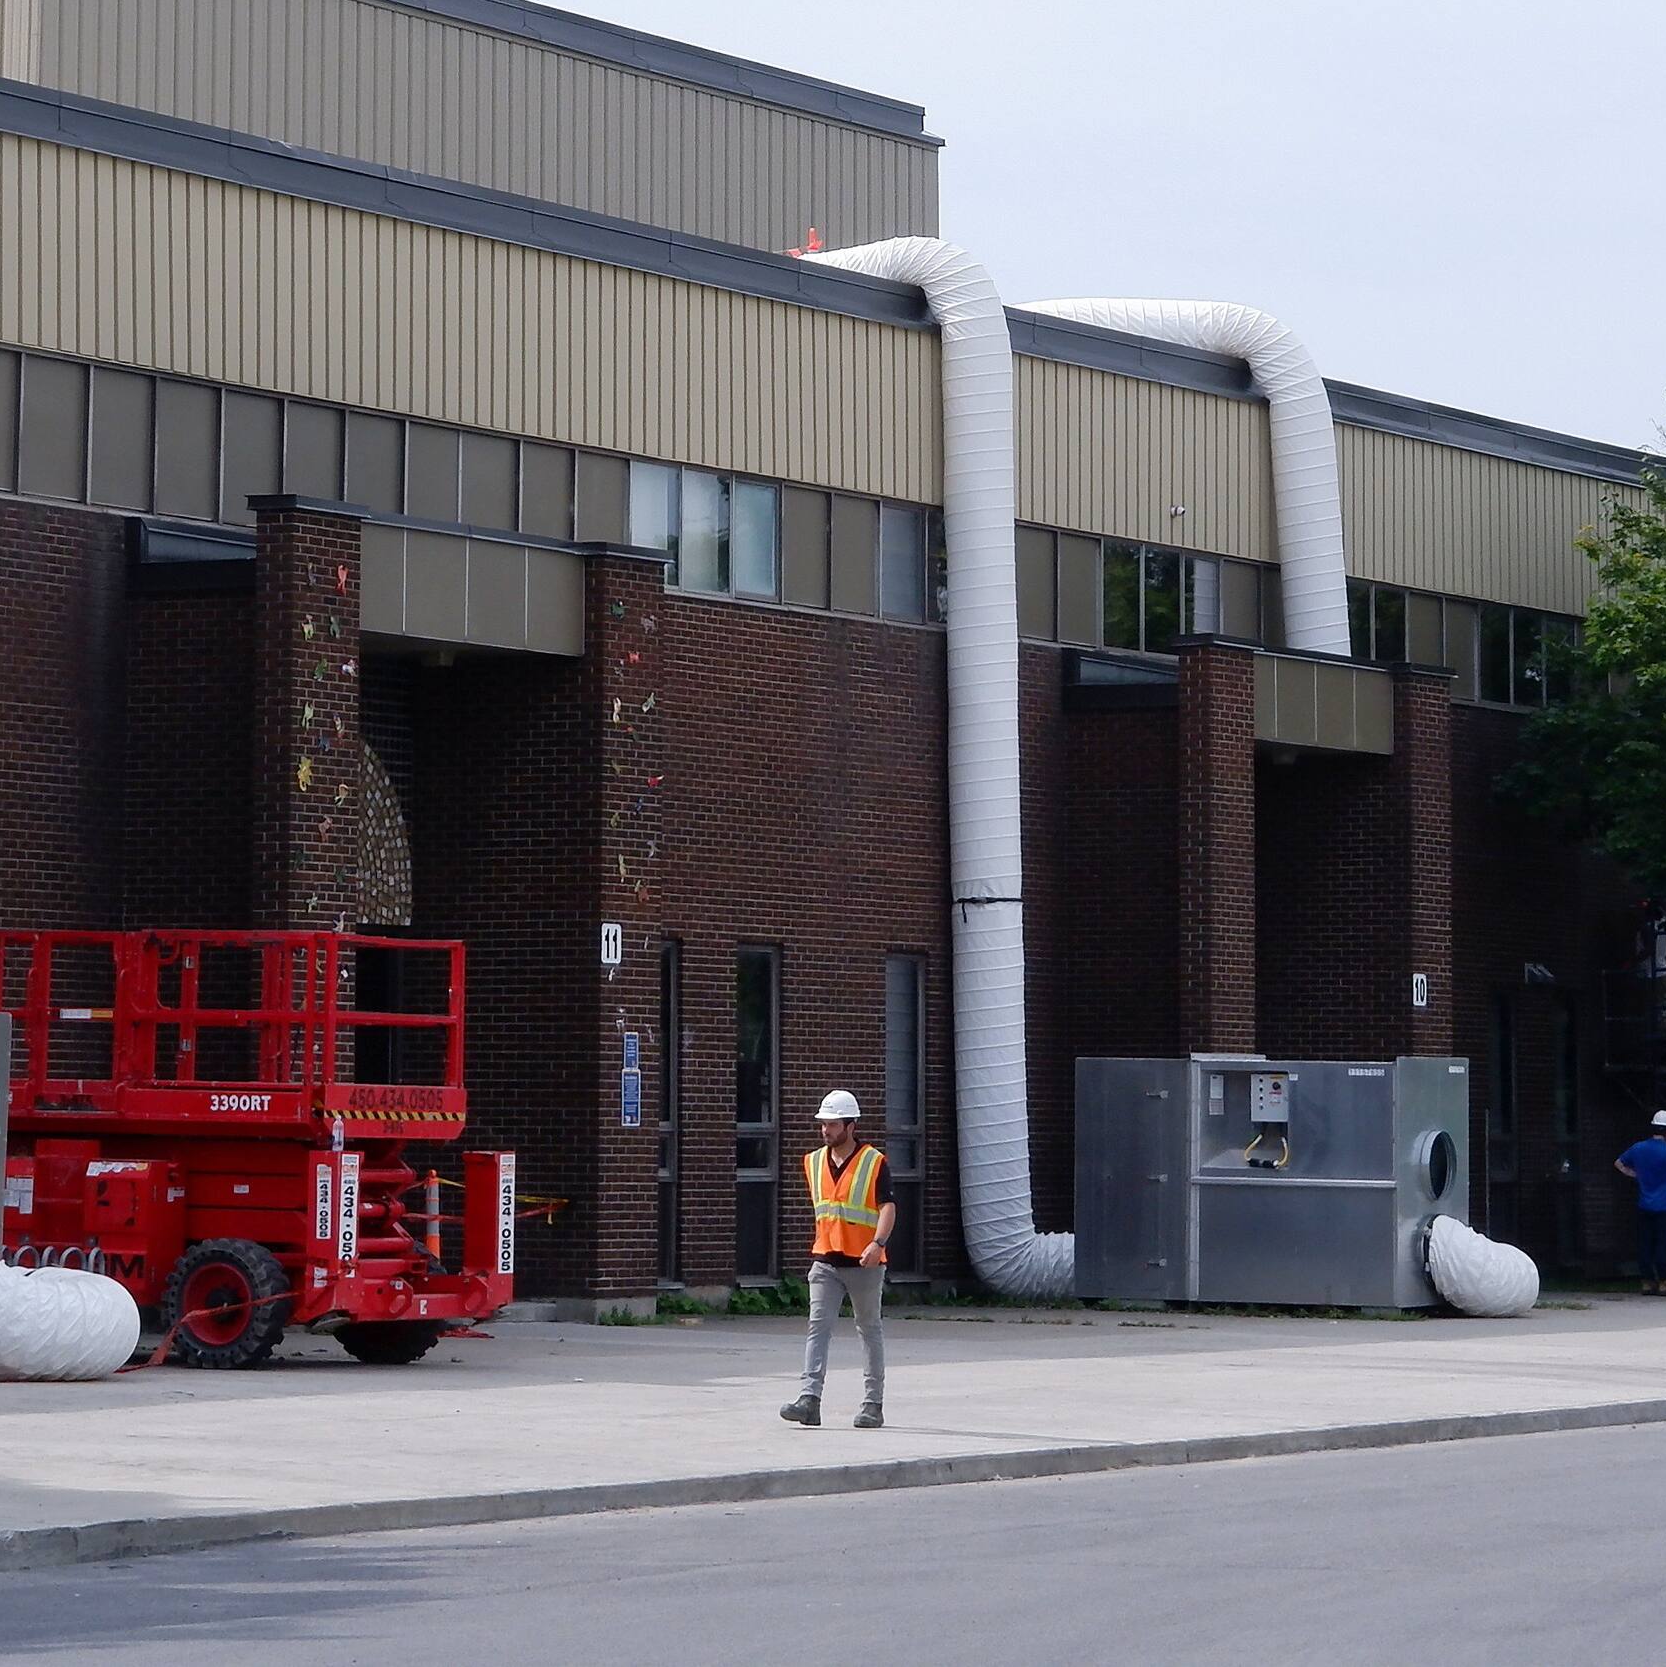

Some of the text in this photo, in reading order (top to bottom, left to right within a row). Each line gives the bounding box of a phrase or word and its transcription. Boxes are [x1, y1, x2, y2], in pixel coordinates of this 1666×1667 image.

[605, 929, 618, 959] 11
[1415, 978, 1425, 1002] 10
[210, 1095, 271, 1111] 3390RT
